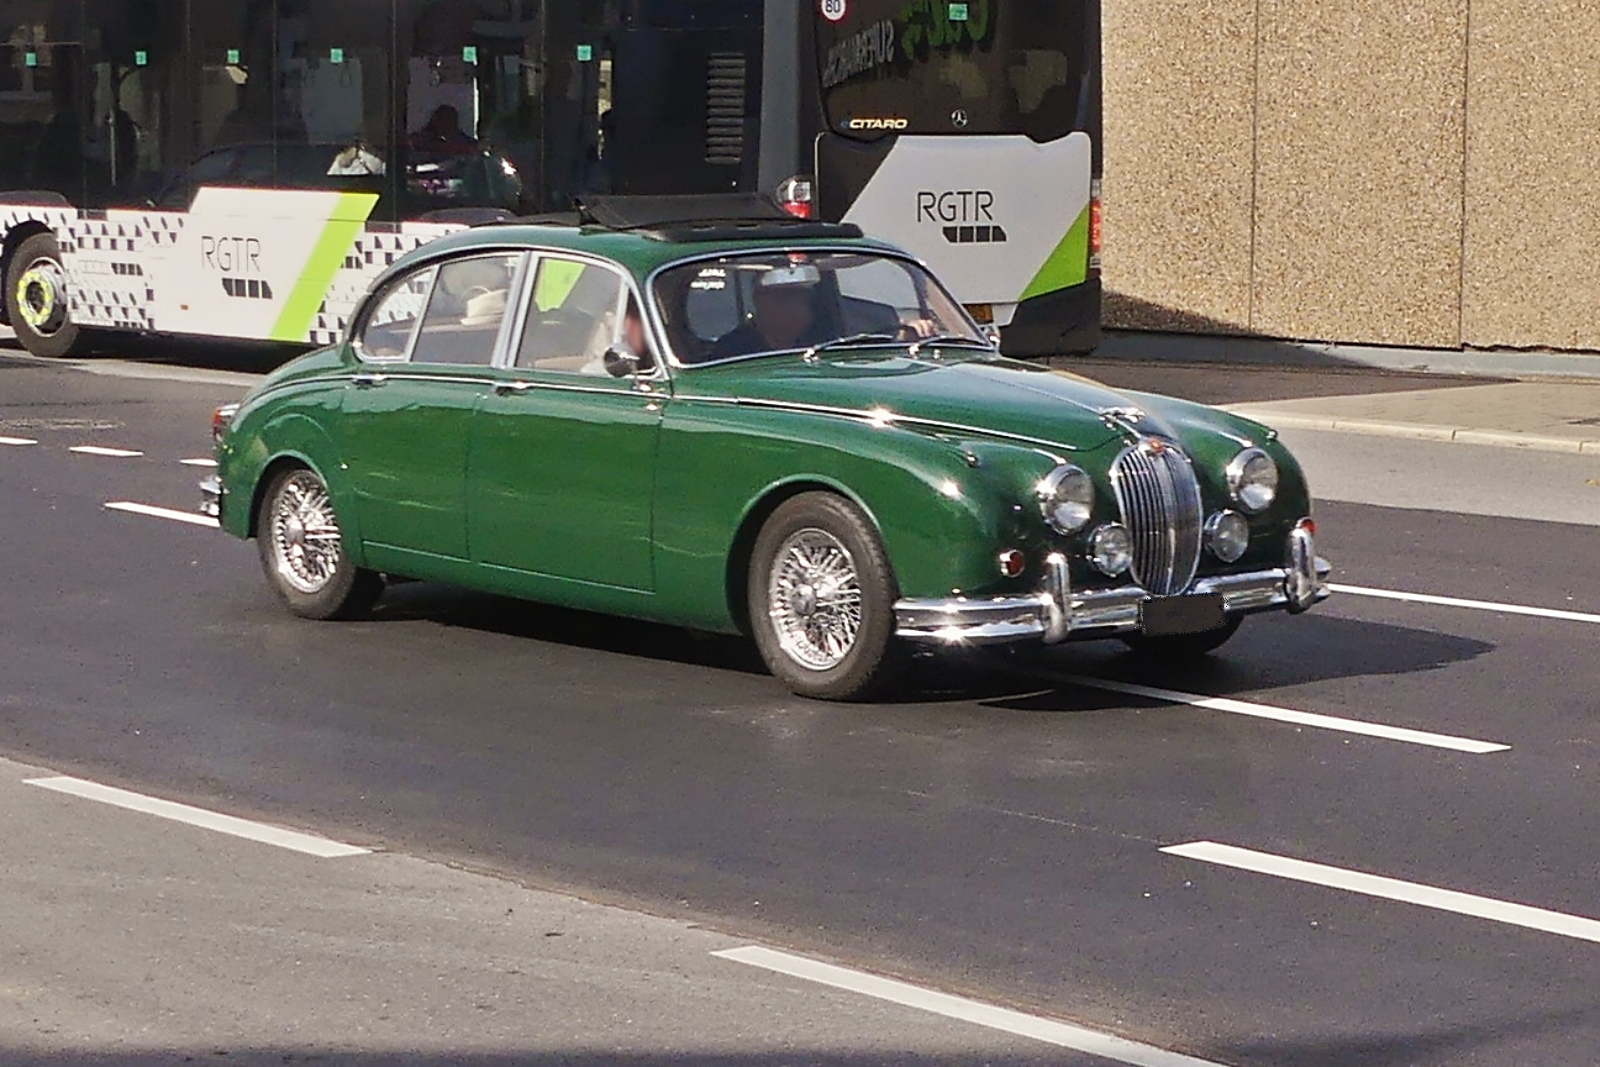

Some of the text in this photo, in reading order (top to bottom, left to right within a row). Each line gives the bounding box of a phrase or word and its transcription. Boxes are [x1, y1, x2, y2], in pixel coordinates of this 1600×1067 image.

[826, 0, 841, 13] 80
[849, 118, 908, 130] CITARO
[917, 190, 994, 223] RGTR
[201, 235, 261, 272] RGTR
